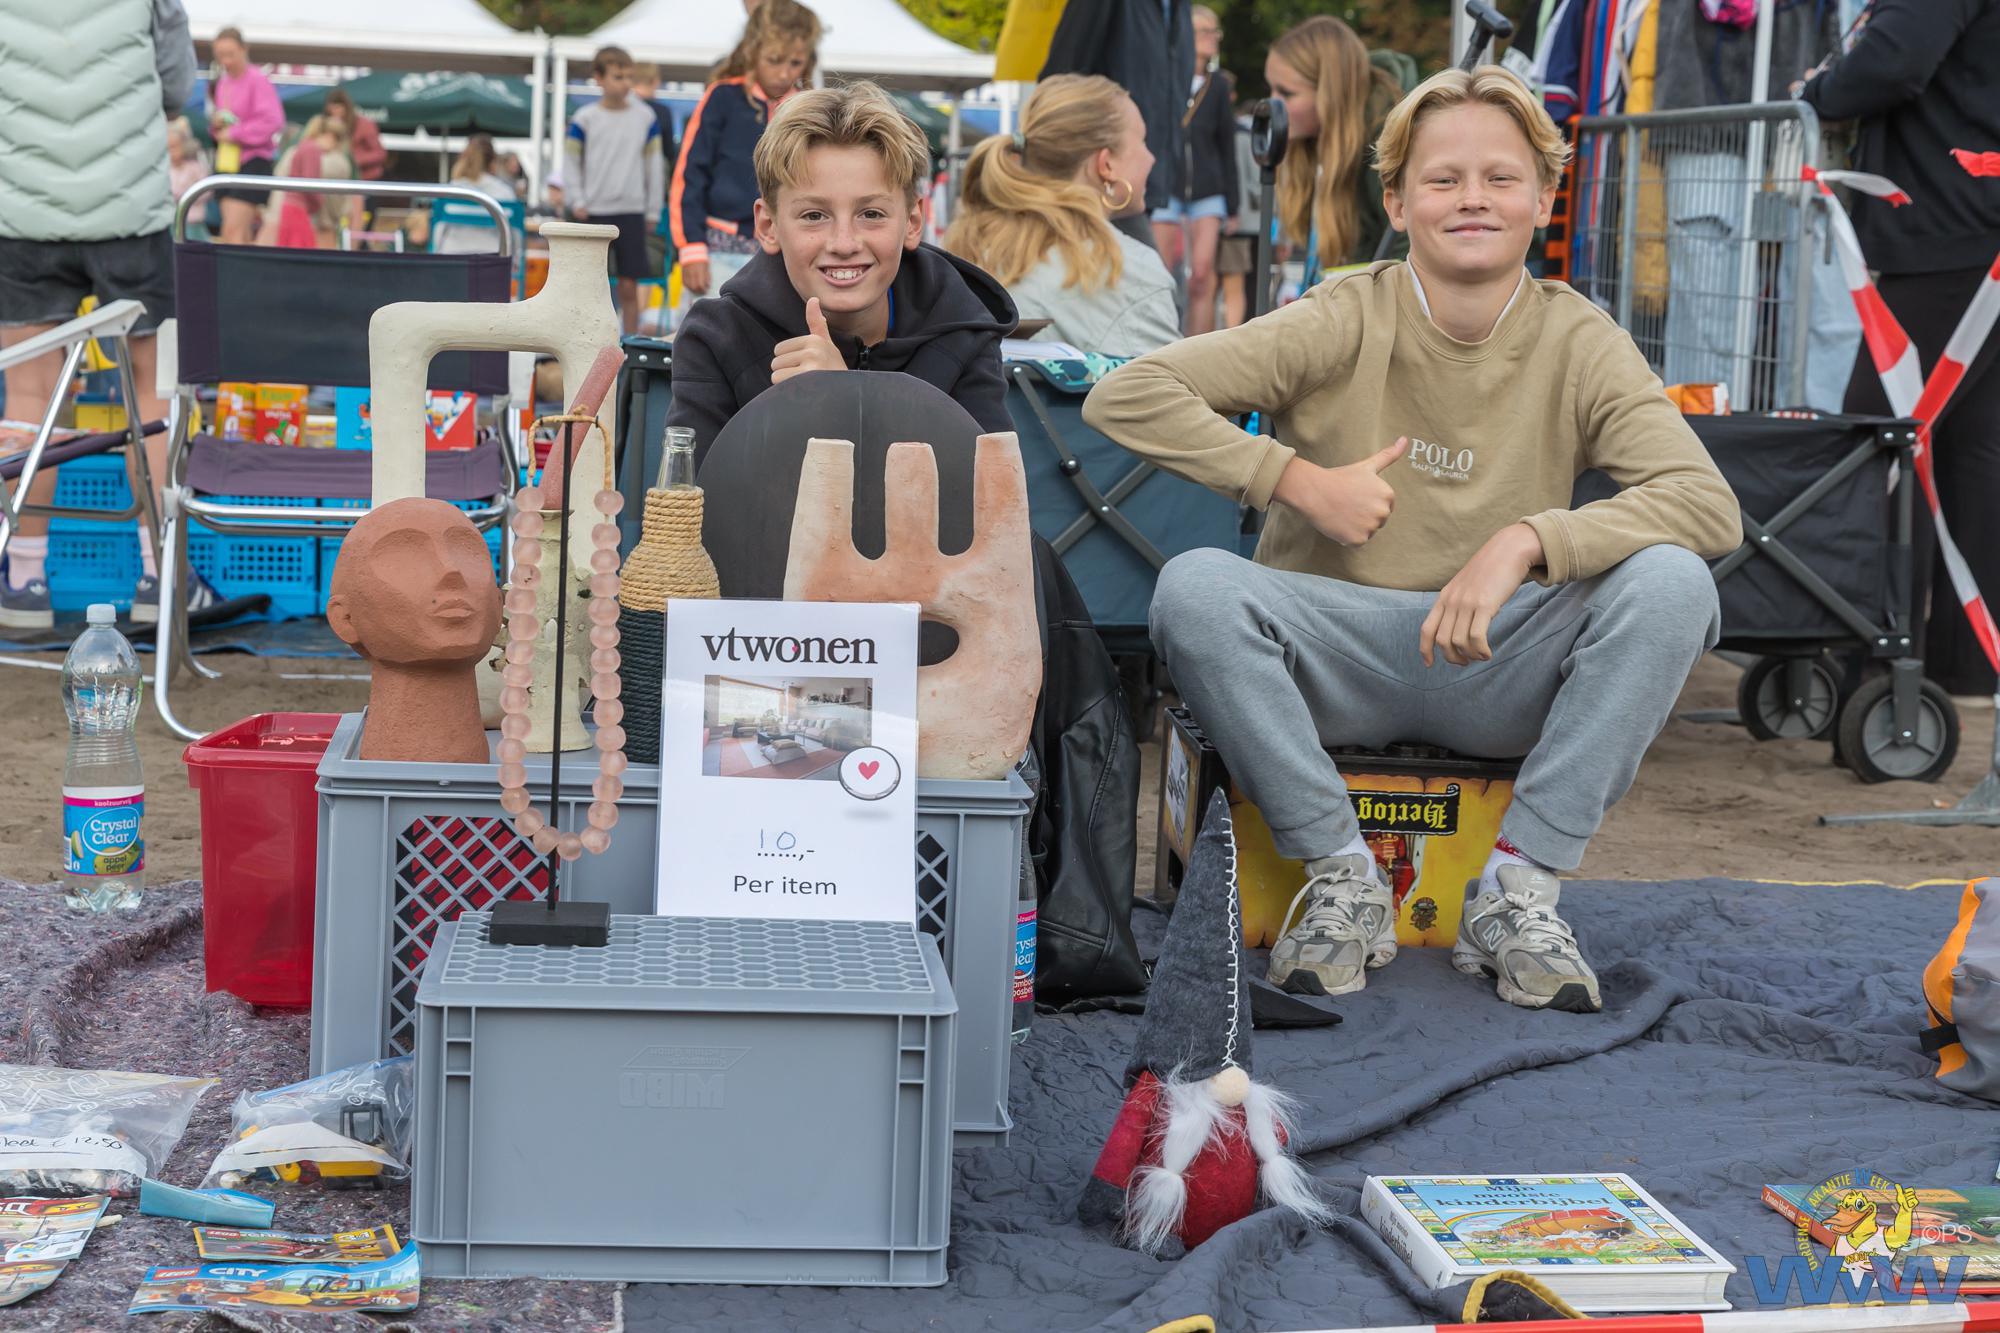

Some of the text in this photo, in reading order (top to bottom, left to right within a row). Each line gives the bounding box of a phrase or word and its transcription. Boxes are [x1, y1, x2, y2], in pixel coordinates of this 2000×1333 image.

[1408, 438, 1474, 472] POLO
[700, 627, 878, 665] vtwonen
[1358, 797, 1448, 829] Hertog
[90, 816, 137, 834] Crystal
[91, 832, 129, 845] Clear
[103, 855, 127, 864] appel
[733, 875, 837, 895] Per item
[1015, 952, 1034, 966] lear
[1485, 1185, 1535, 1193] Mijn
[1436, 1197, 1614, 1207] kinderbijbel
[208, 1267, 269, 1278] CITY
